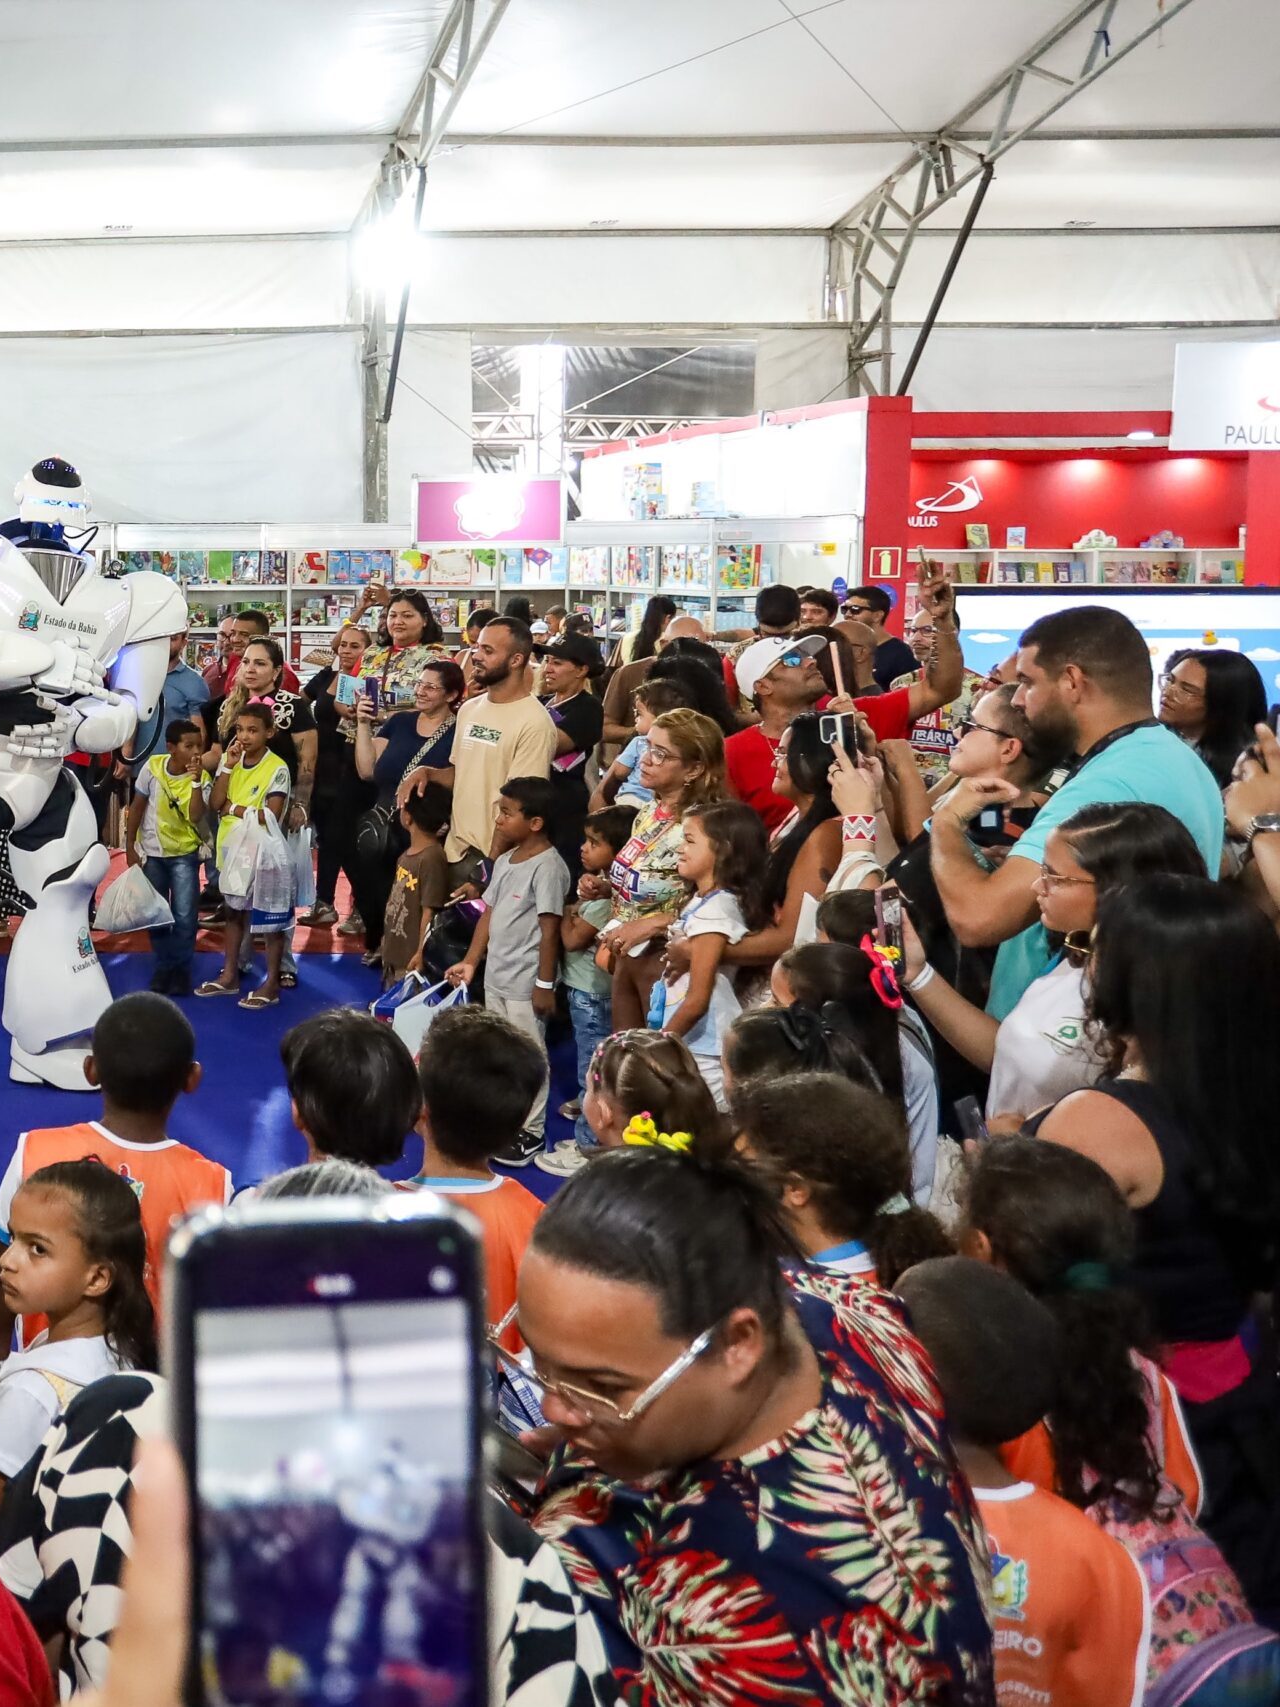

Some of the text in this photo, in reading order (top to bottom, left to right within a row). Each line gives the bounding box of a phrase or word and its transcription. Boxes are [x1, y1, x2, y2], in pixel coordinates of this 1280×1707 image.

[43, 614, 98, 635] Estado da Bahia
